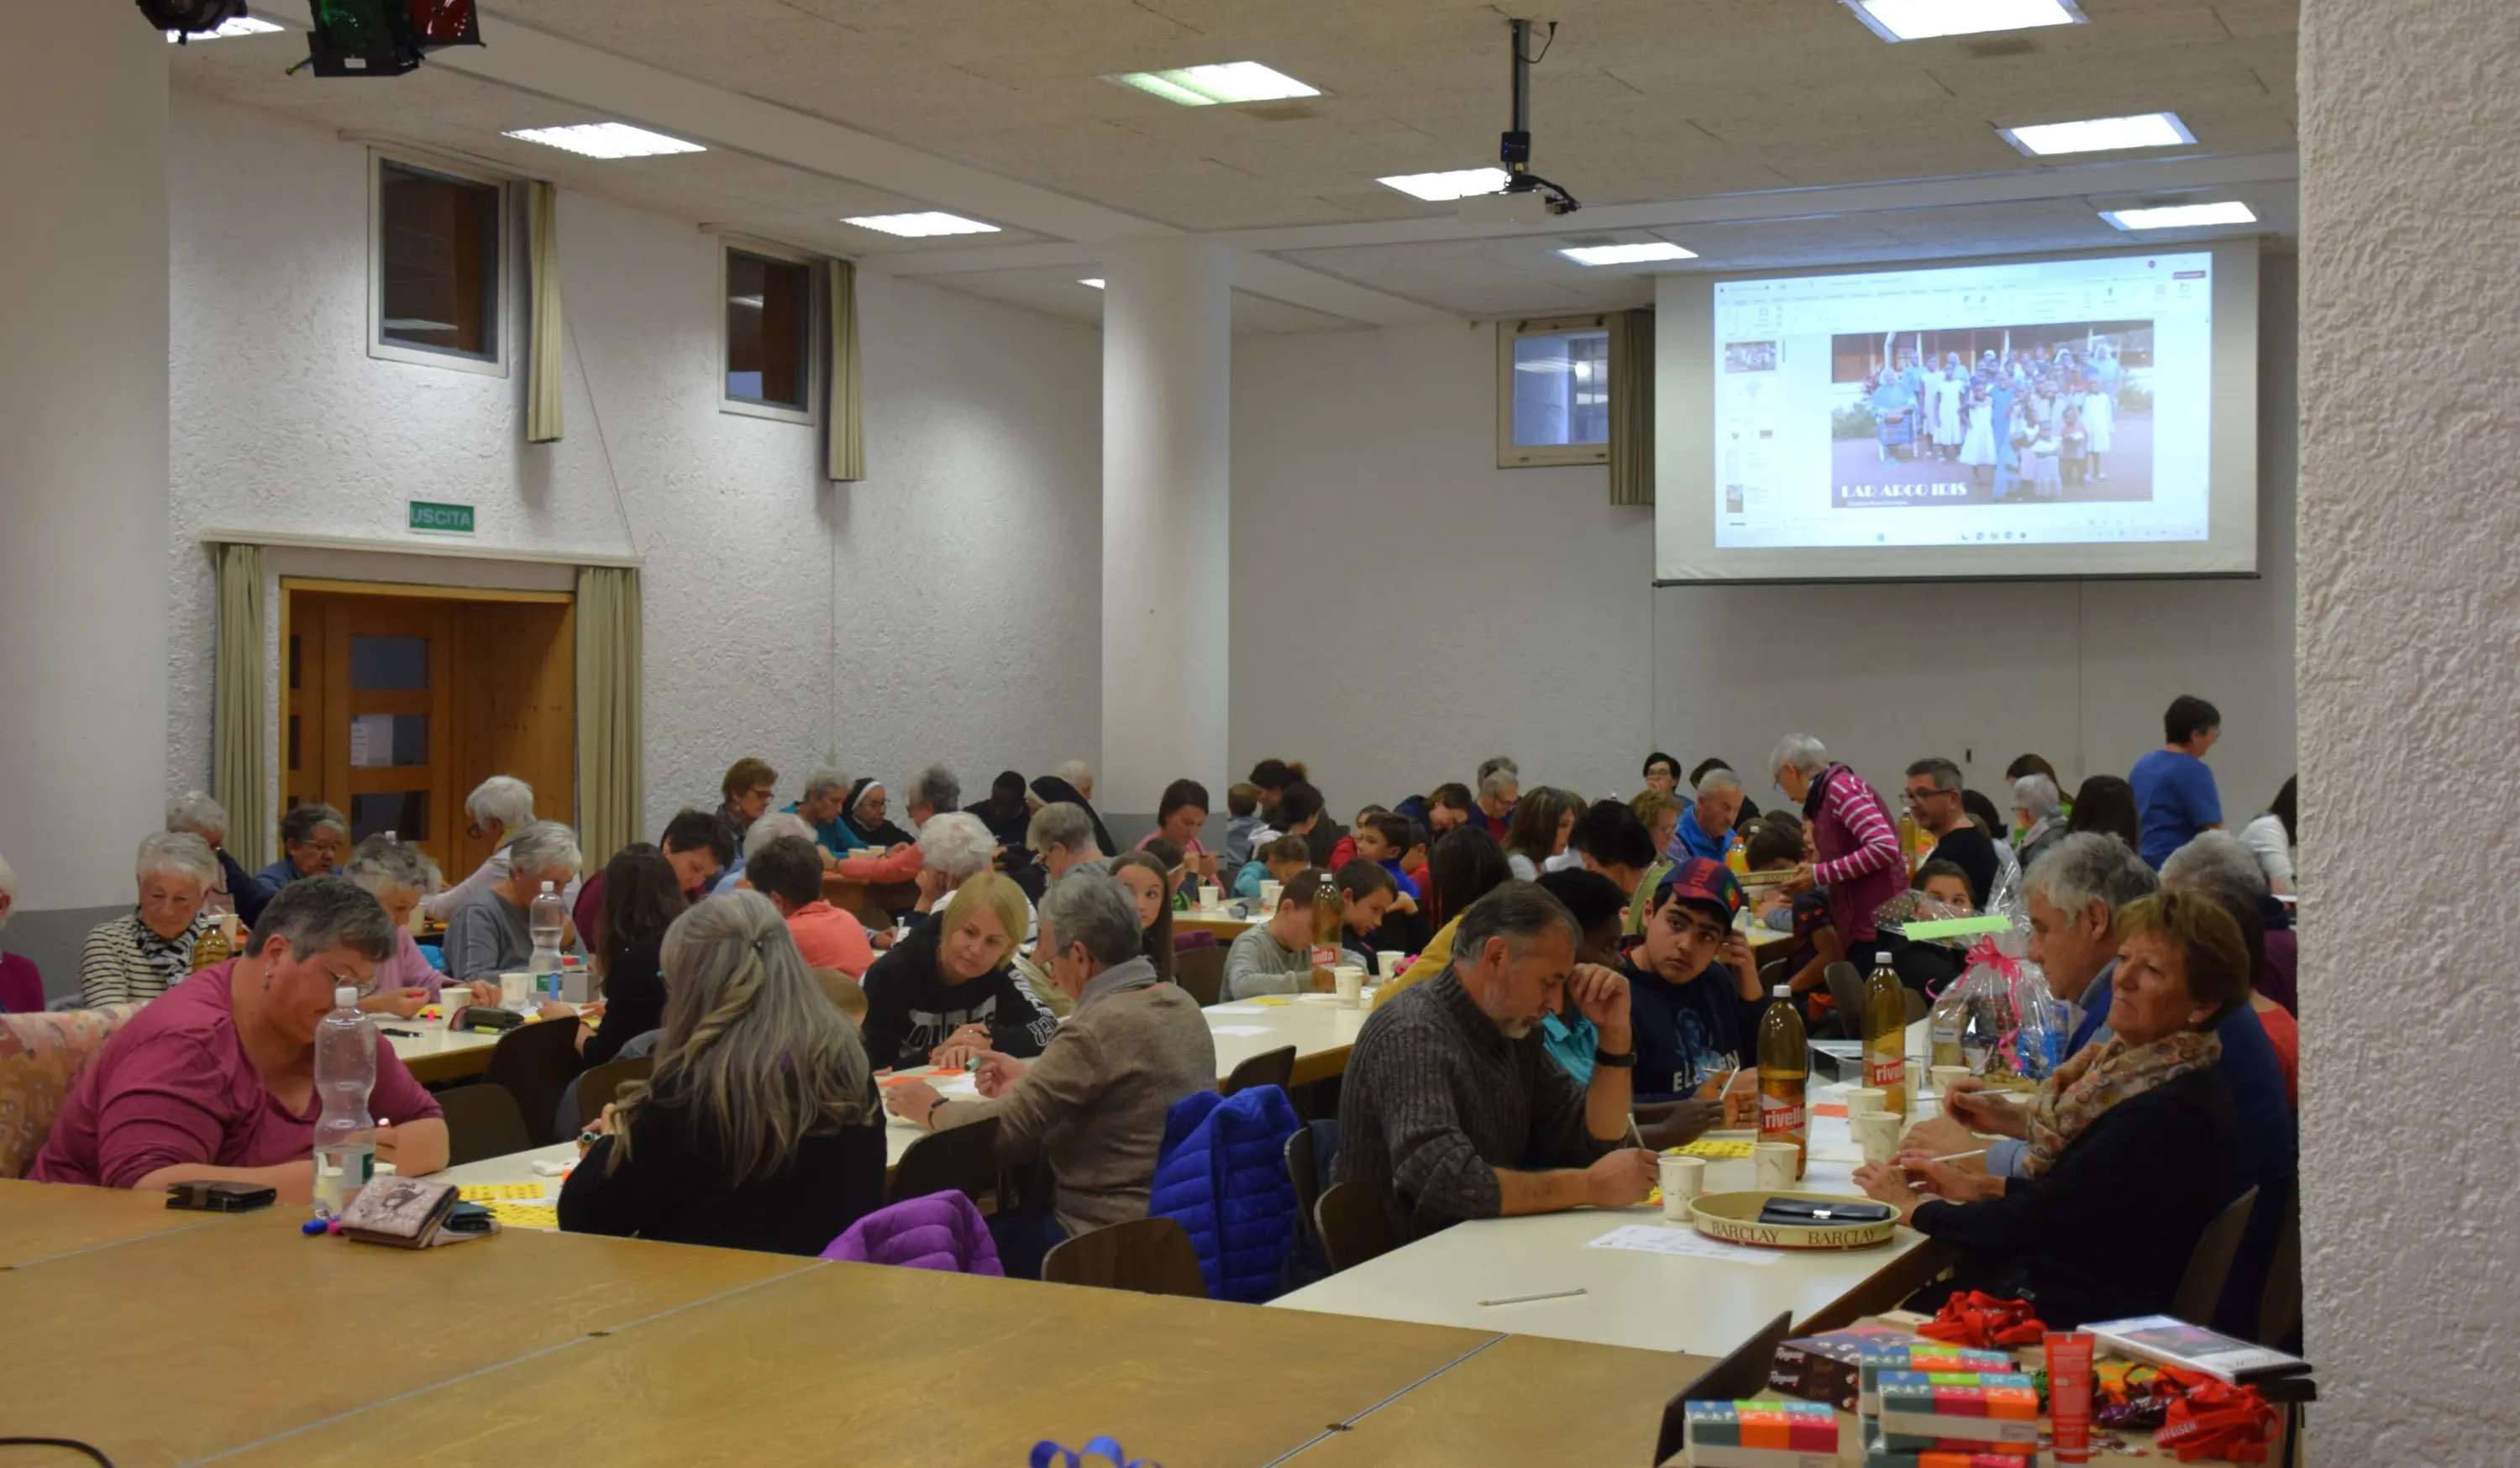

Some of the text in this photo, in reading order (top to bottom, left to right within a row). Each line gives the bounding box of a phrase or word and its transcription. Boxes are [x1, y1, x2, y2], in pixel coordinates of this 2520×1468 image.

[1841, 482, 1968, 498] LAR ARCO IRIS
[410, 507, 470, 526] USCITA
[1712, 1221, 1780, 1244] BARCLAY
[1807, 1226, 1877, 1245] BARCLAY
